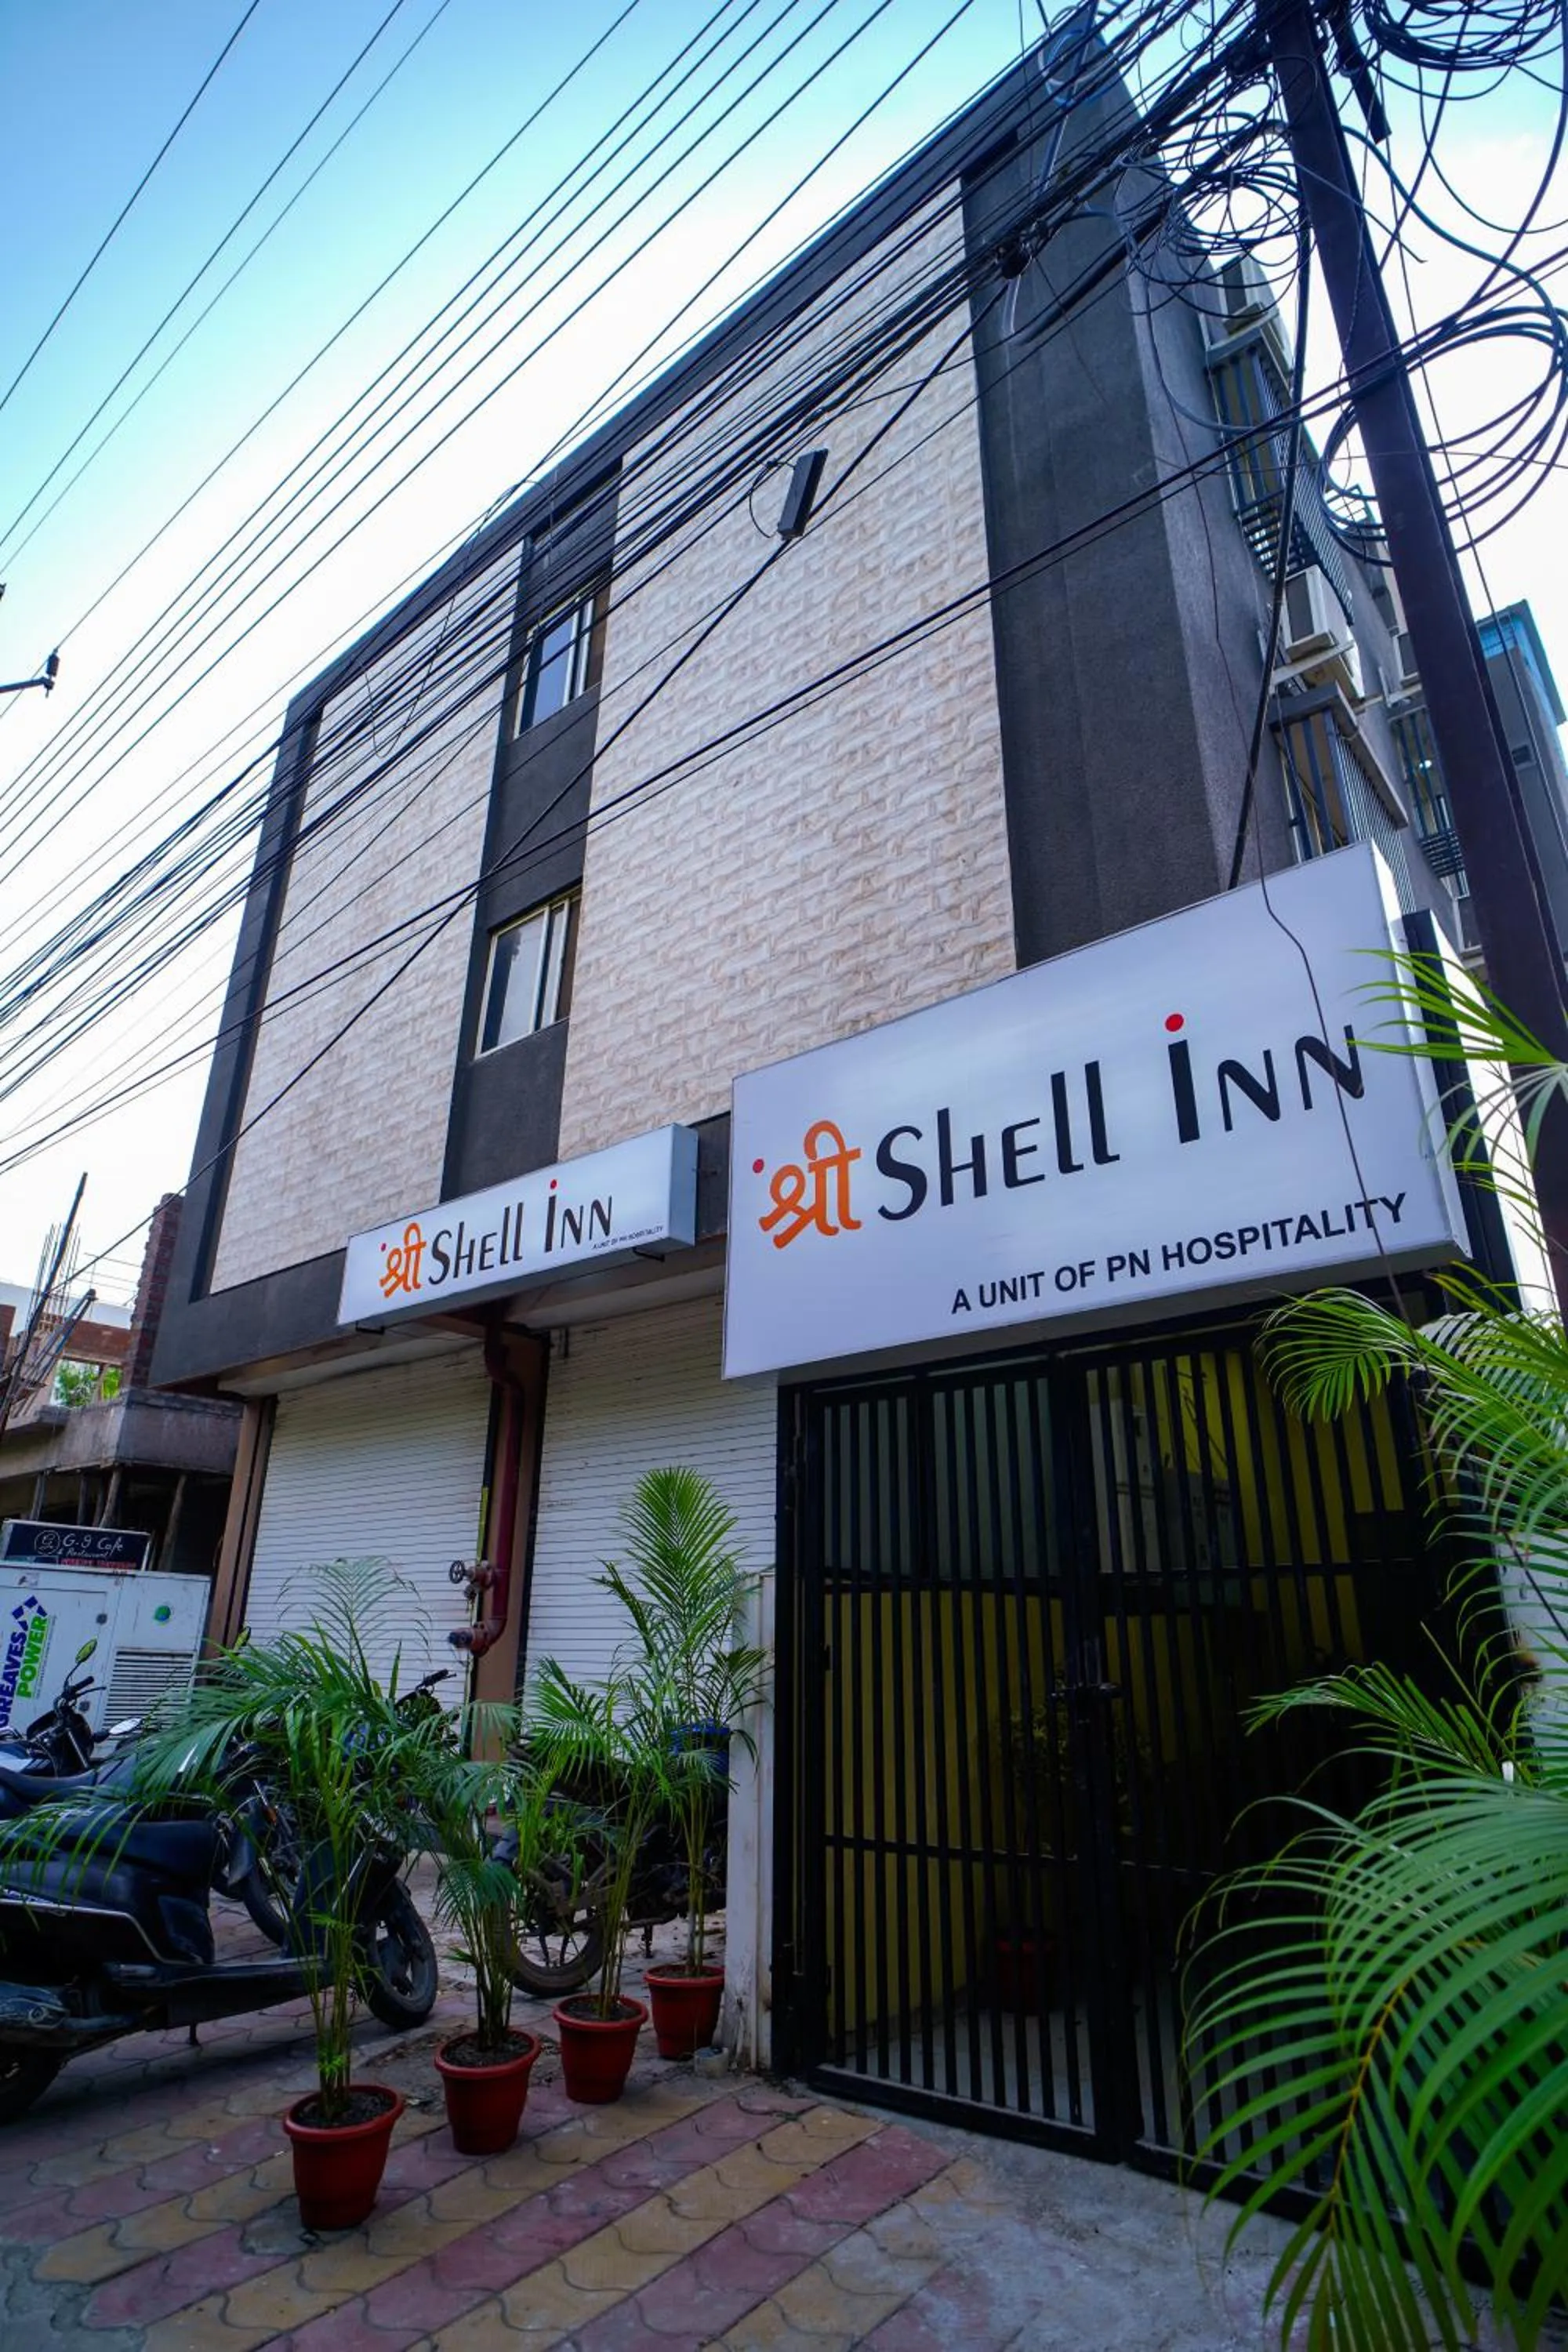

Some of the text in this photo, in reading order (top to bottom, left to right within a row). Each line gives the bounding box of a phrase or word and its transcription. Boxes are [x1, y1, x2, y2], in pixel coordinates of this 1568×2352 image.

[758, 1120, 862, 1250] श्री
[379, 1221, 428, 1298] श्री
[951, 1192, 1407, 1315] A UNIT OF PN HOSPITALITY
[16, 1616, 48, 1698] POWER
